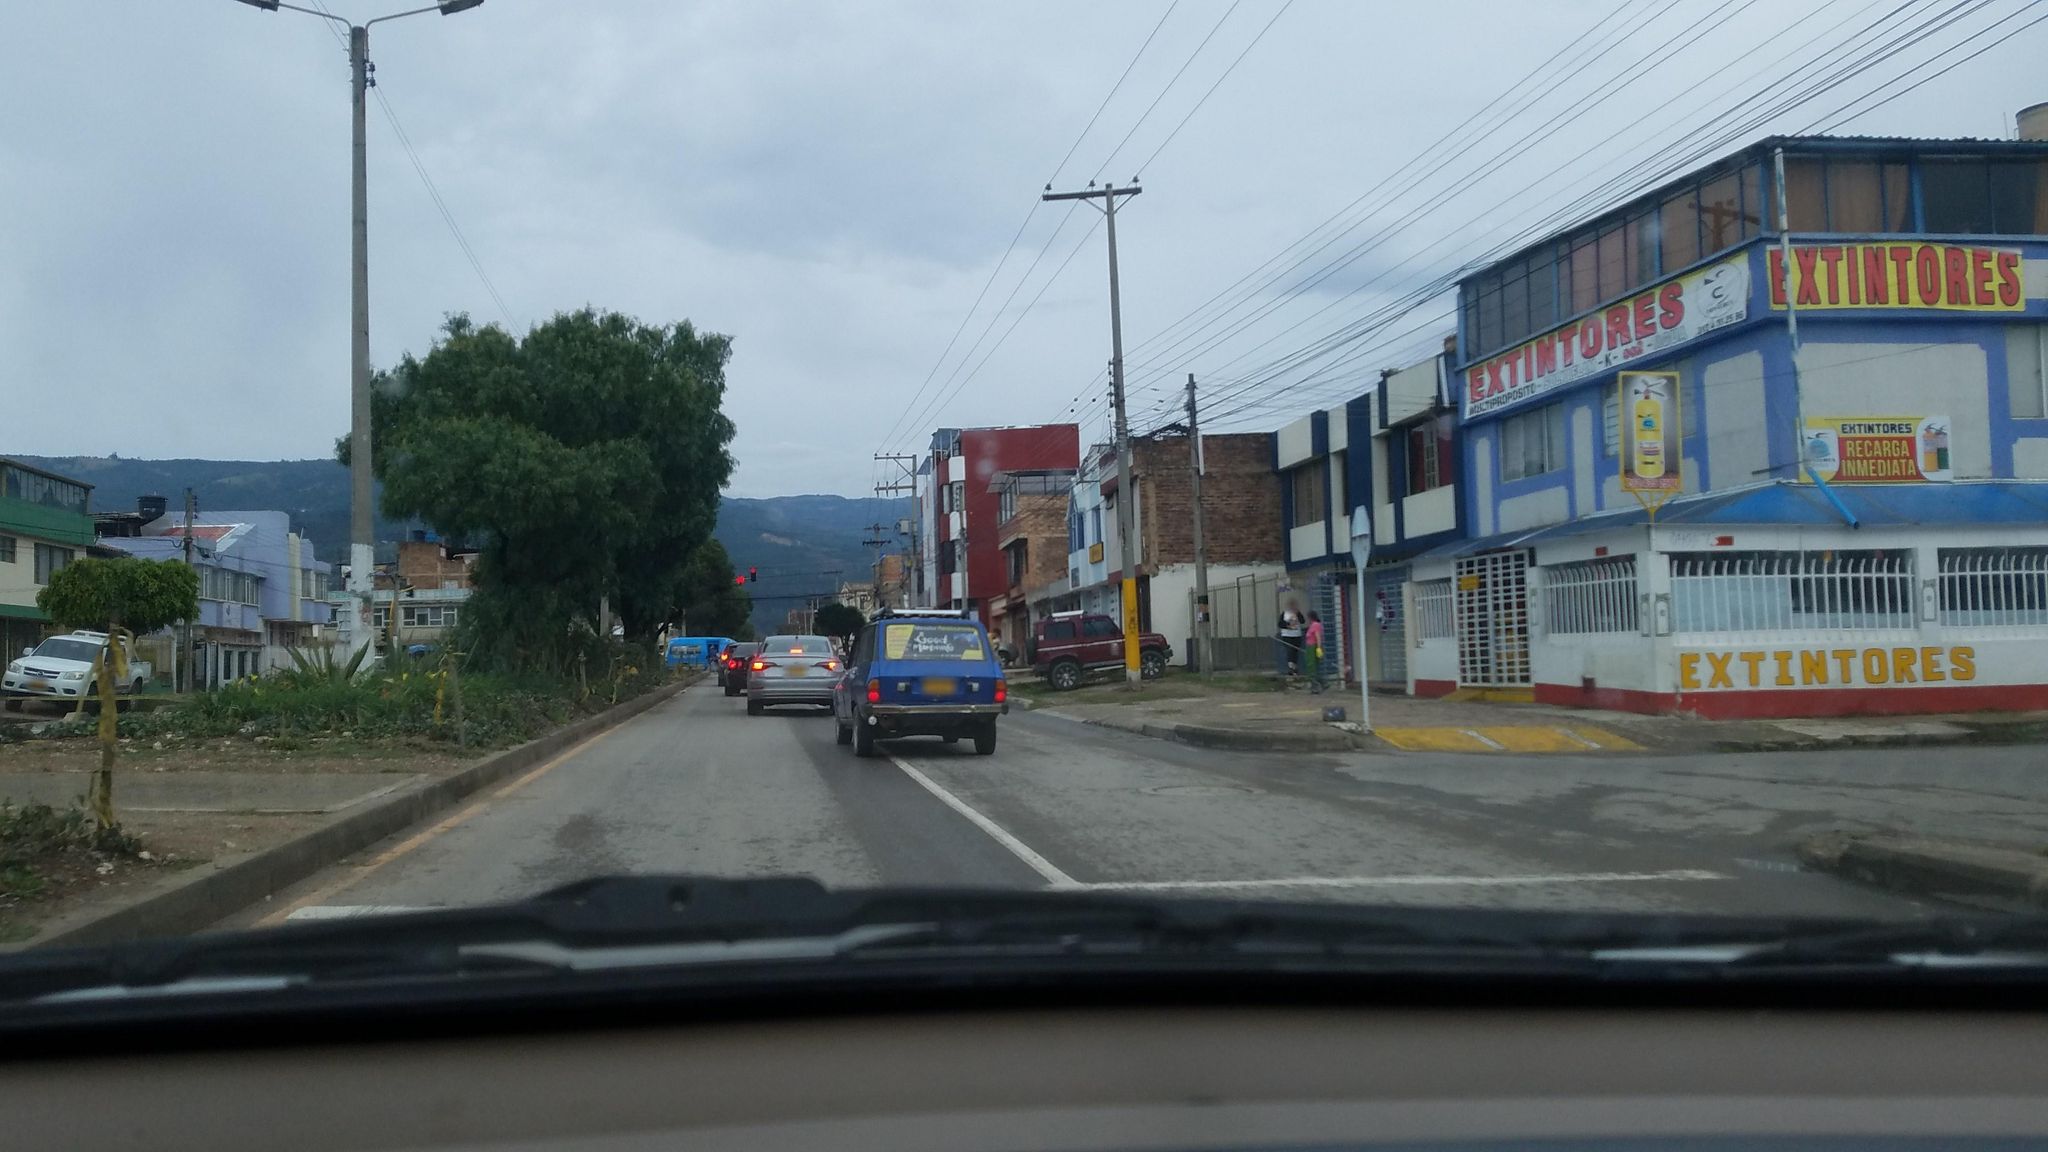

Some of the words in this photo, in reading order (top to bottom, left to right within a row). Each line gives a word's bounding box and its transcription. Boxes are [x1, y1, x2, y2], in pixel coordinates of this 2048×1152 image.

[1770, 245, 2021, 306] EXTINTORES
[1469, 282, 1685, 404] EXTINTORES
[1469, 383, 1536, 415] MULTIPROPOSITO
[1841, 423, 1912, 434] EXTINTORES
[1846, 440, 1910, 457] RECARGA
[1842, 458, 1917, 477] INMEDIATA
[1679, 646, 1976, 689] EXTINTORES
